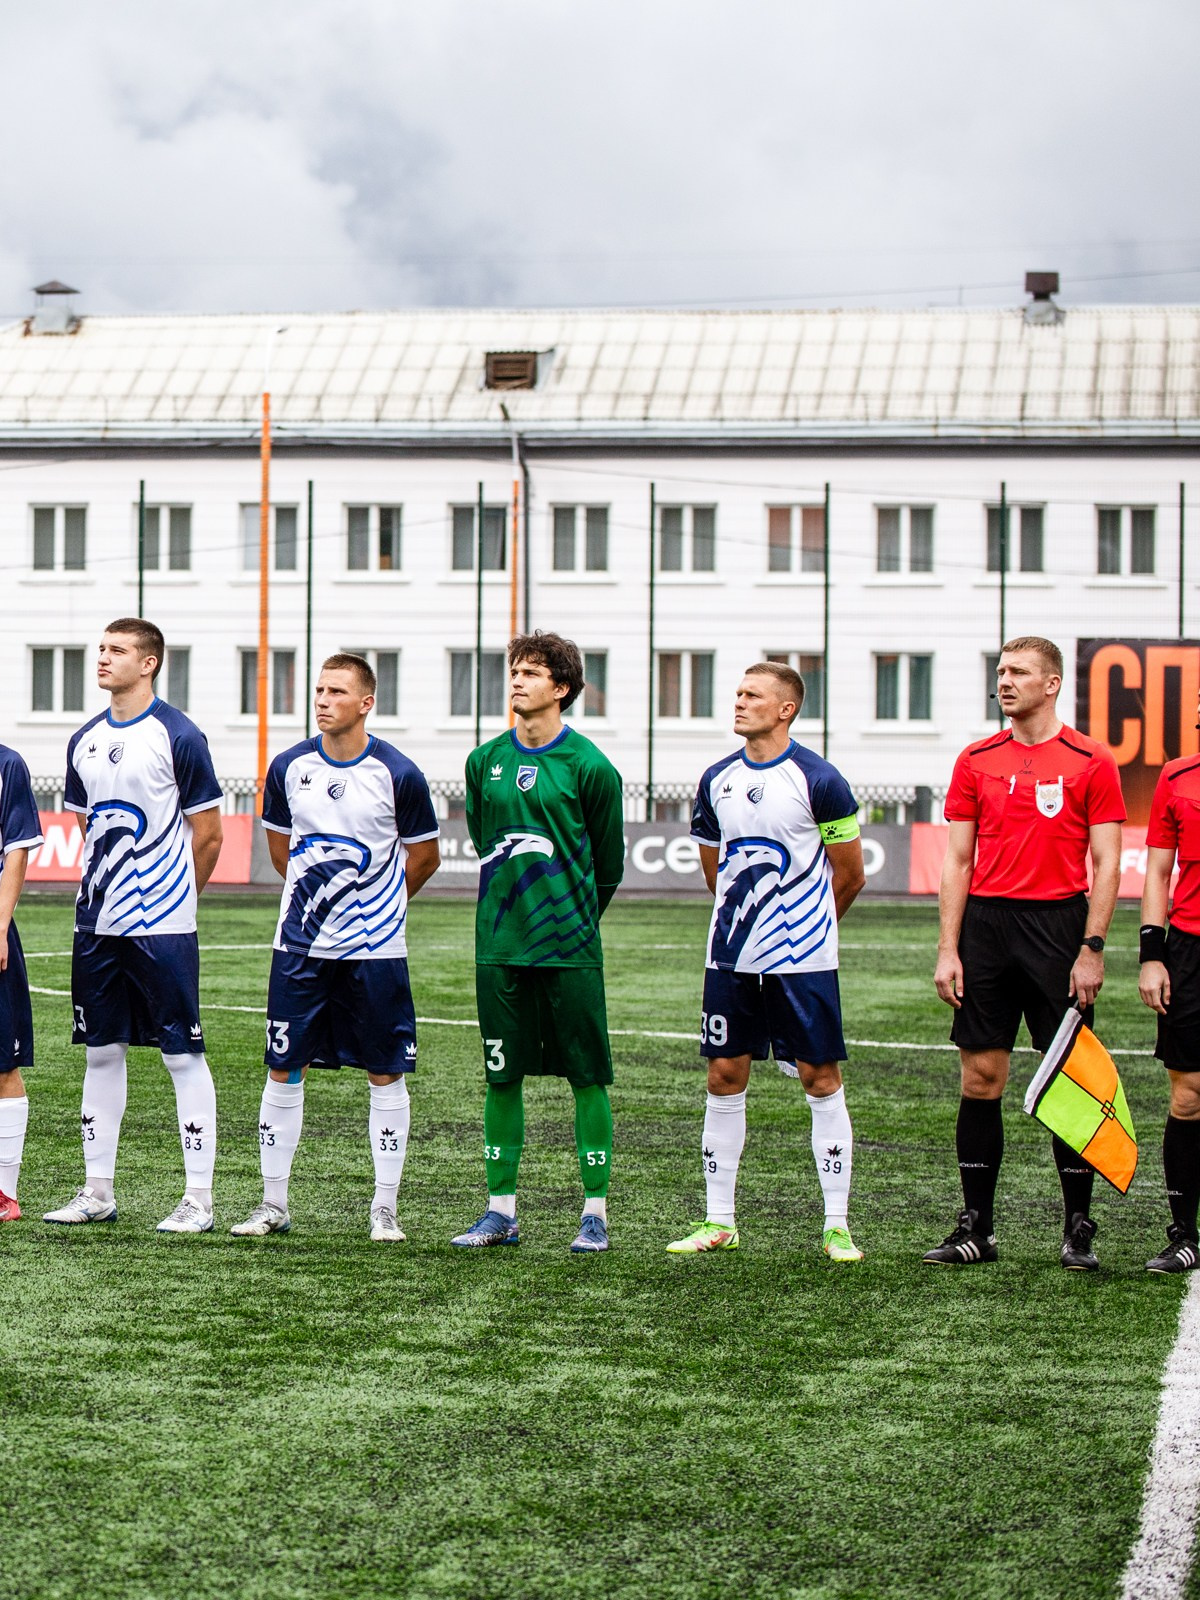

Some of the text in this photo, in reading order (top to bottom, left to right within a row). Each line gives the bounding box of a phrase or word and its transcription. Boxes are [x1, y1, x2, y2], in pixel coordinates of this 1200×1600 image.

[482, 1038, 506, 1071] 3
[184, 1136, 202, 1151] 83
[379, 1138, 398, 1151] 33
[484, 1146, 501, 1161] 53
[587, 1151, 606, 1166] 53
[822, 1158, 842, 1174] 39
